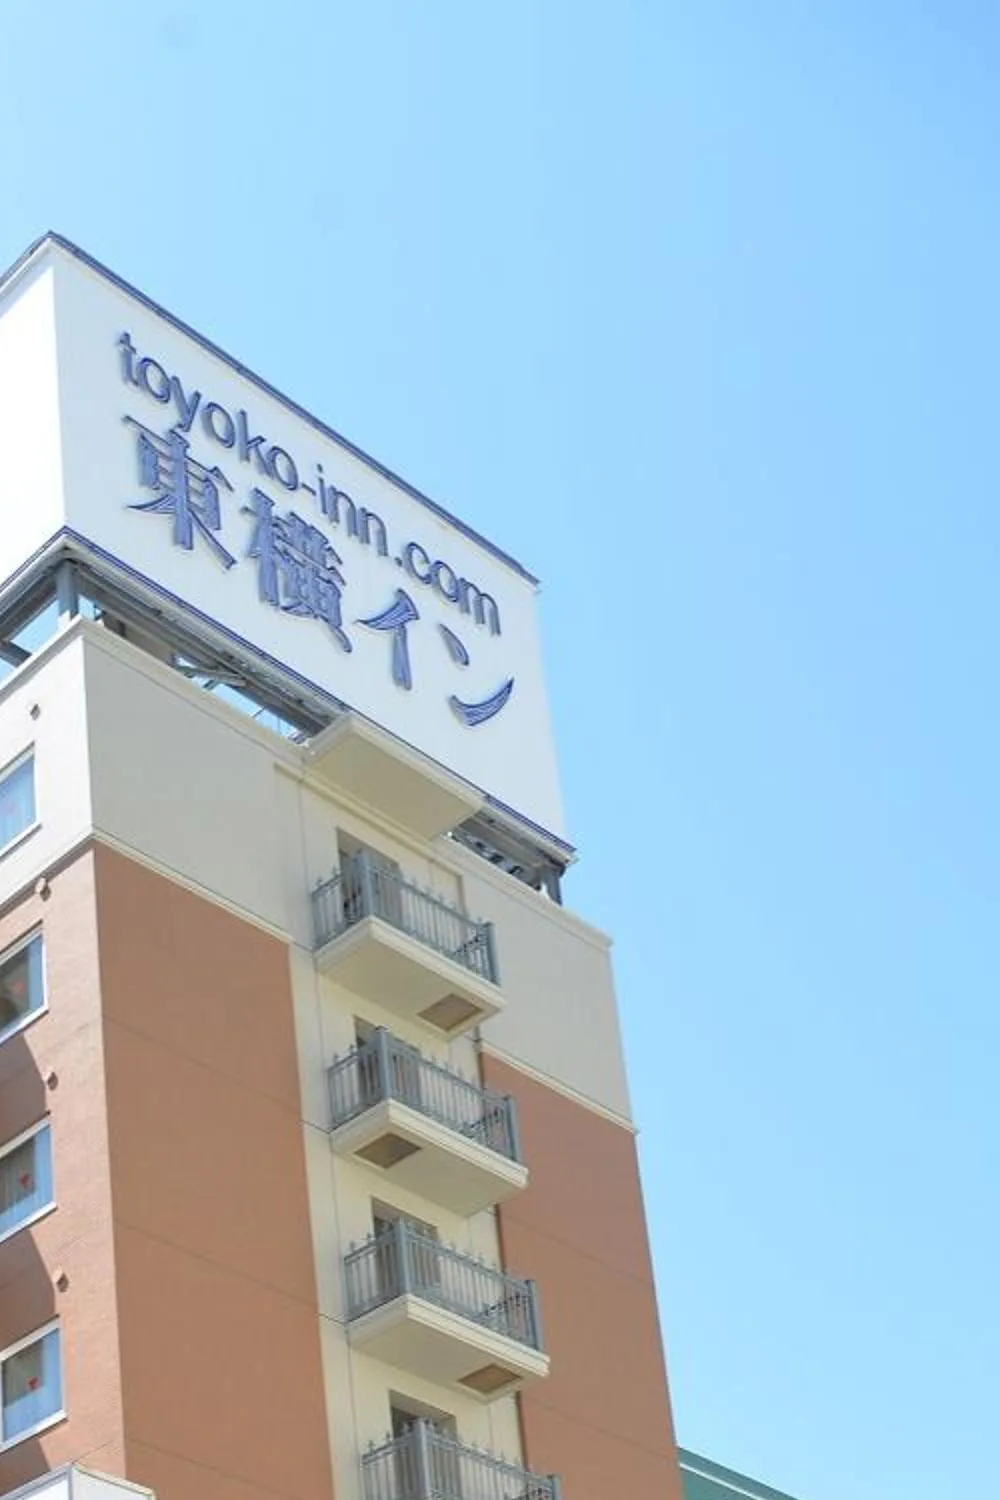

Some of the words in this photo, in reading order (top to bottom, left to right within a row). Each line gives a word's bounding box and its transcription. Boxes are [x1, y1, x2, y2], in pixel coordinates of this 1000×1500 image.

[116, 331, 502, 637] toyoko-inn.com
[122, 414, 515, 727] 東横イン
